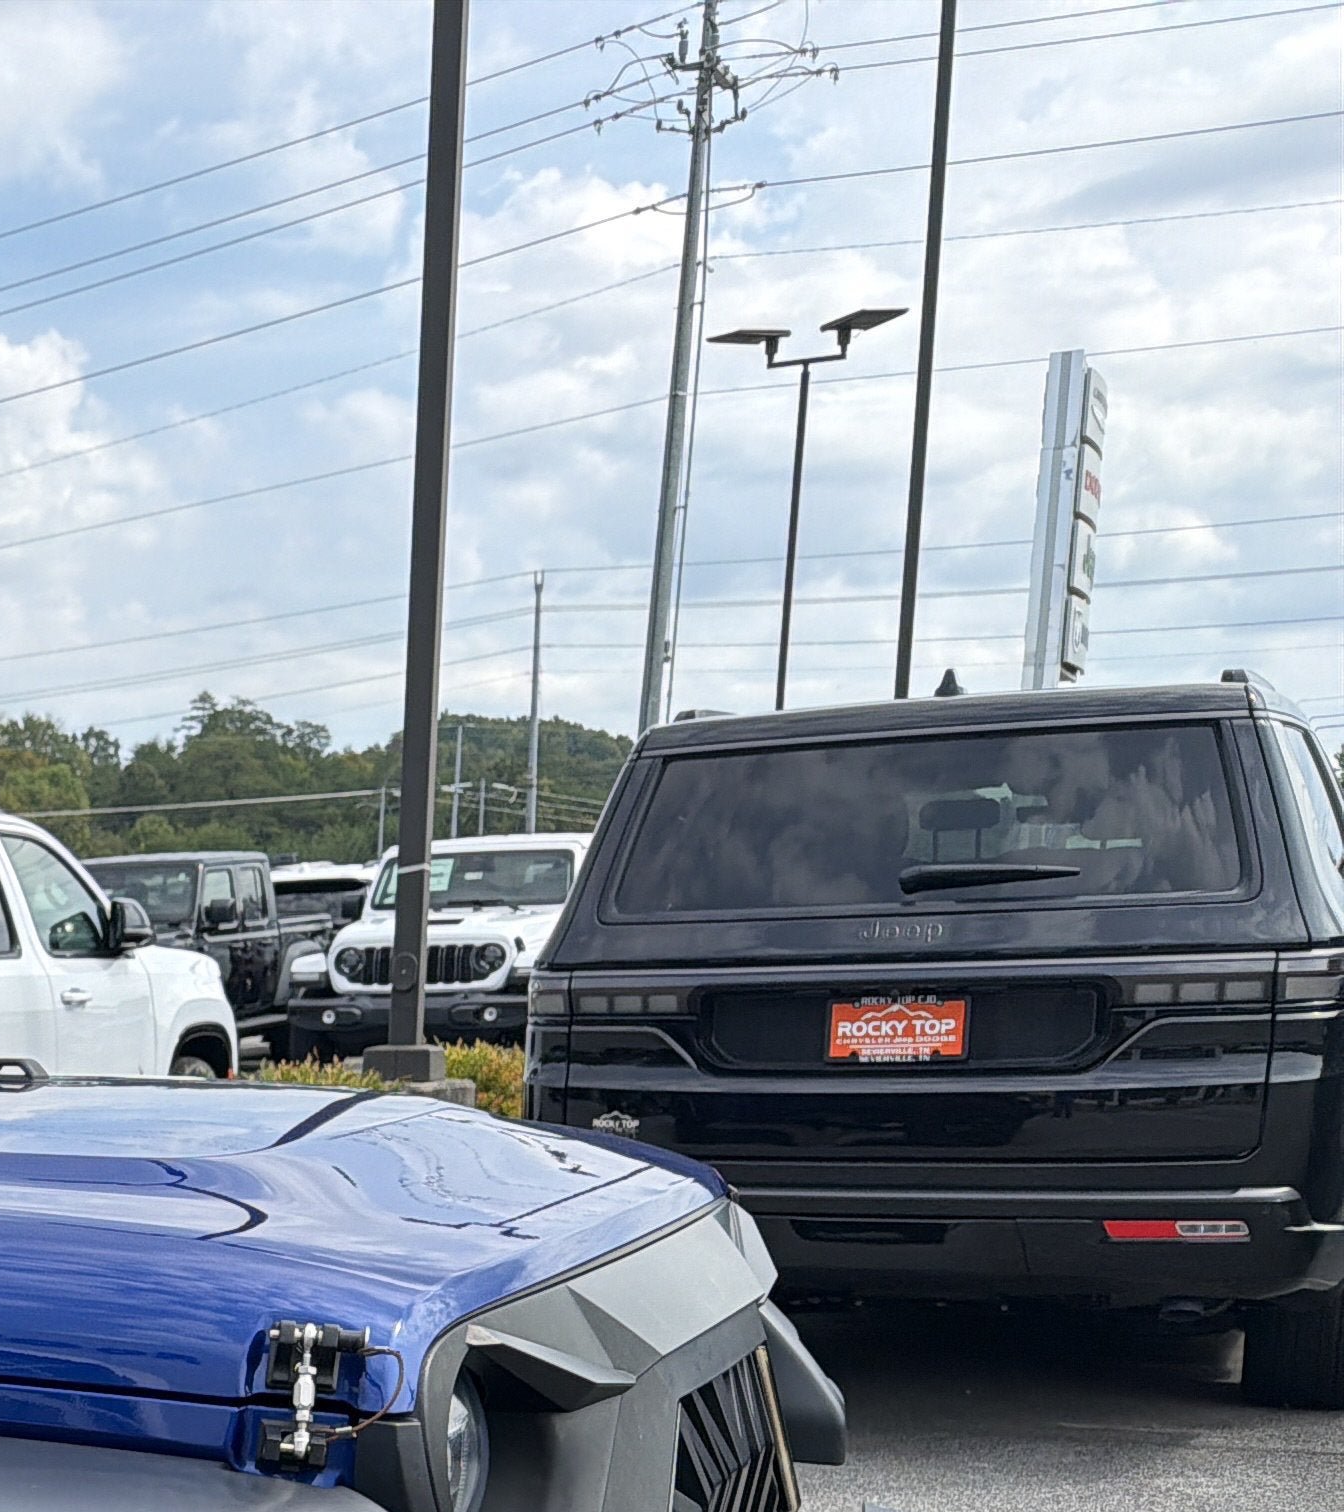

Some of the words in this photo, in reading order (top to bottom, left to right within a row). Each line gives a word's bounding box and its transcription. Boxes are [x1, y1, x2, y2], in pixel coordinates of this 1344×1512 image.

[837, 1019, 908, 1037] ROCKY
[911, 1018, 957, 1035] TOP
[835, 1036, 892, 1045] CHRYSLER
[916, 1035, 957, 1043] DODGE
